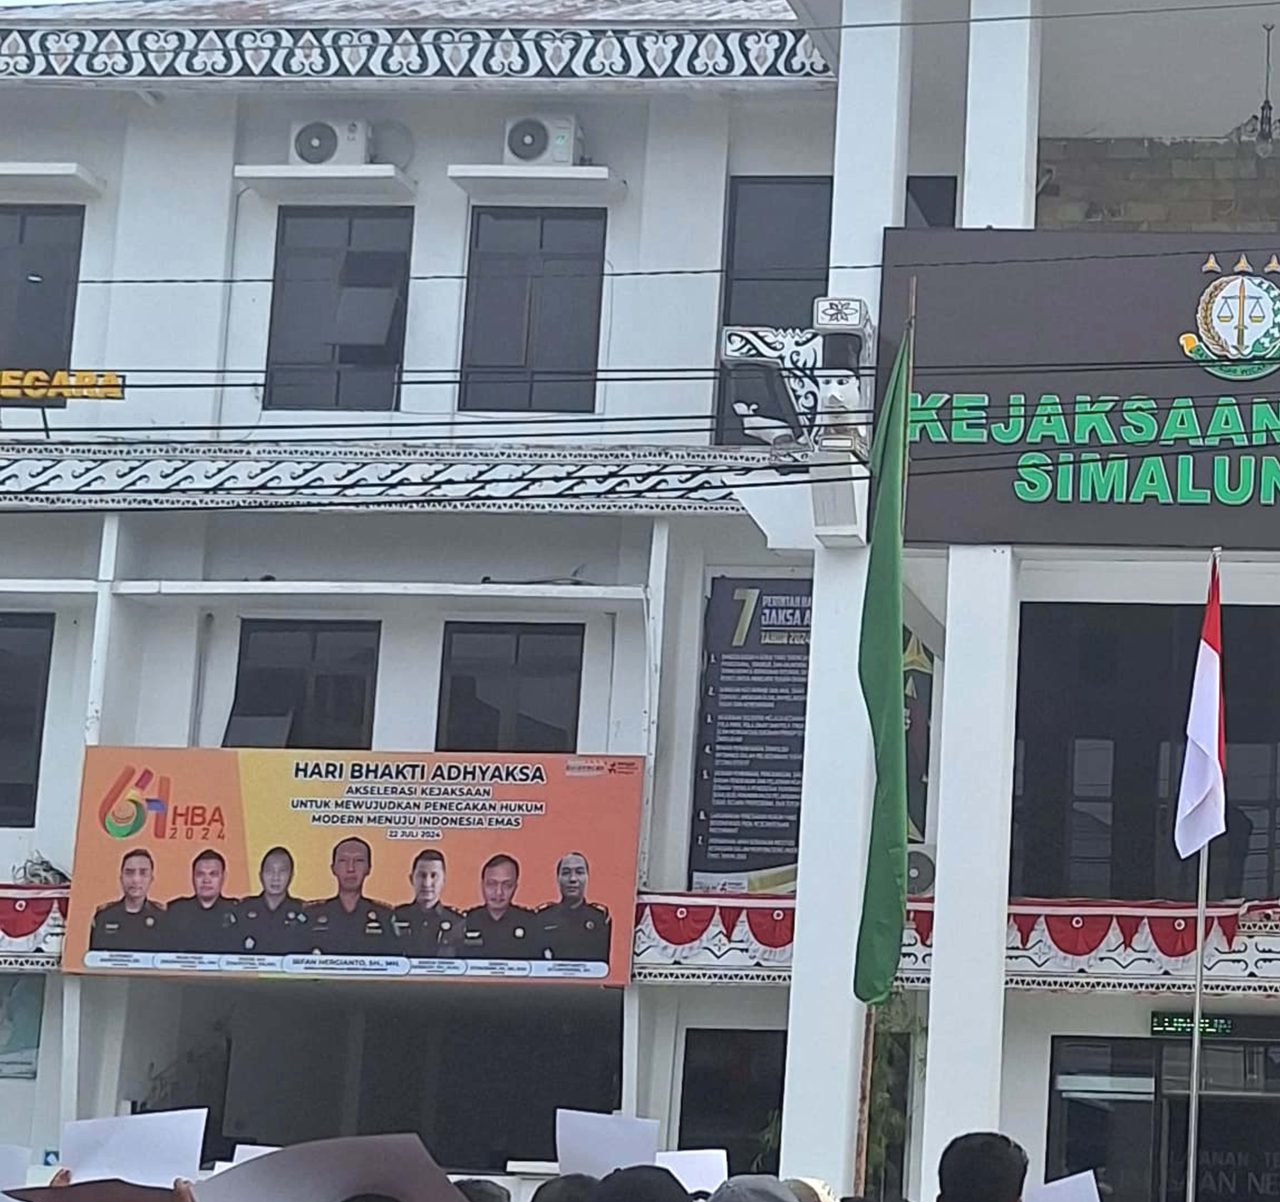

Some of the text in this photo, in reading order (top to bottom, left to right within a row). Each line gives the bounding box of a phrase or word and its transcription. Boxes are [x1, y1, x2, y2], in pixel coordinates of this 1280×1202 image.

[731, 588, 760, 646] 7
[761, 609, 800, 626] JAKSA
[294, 762, 343, 779] HARI
[350, 763, 426, 781] BHAKTI
[431, 765, 545, 783] ADHYAKSA
[346, 786, 491, 798] AKSELERASI KEJAKSAAN
[291, 800, 545, 813] UNTUK MEWUJUDKAN PENEGAKAN HUKUM
[171, 806, 225, 827] HBA
[312, 815, 521, 827] MODERN MENUJU INDONESIA EMAS
[169, 828, 225, 841] 2024
